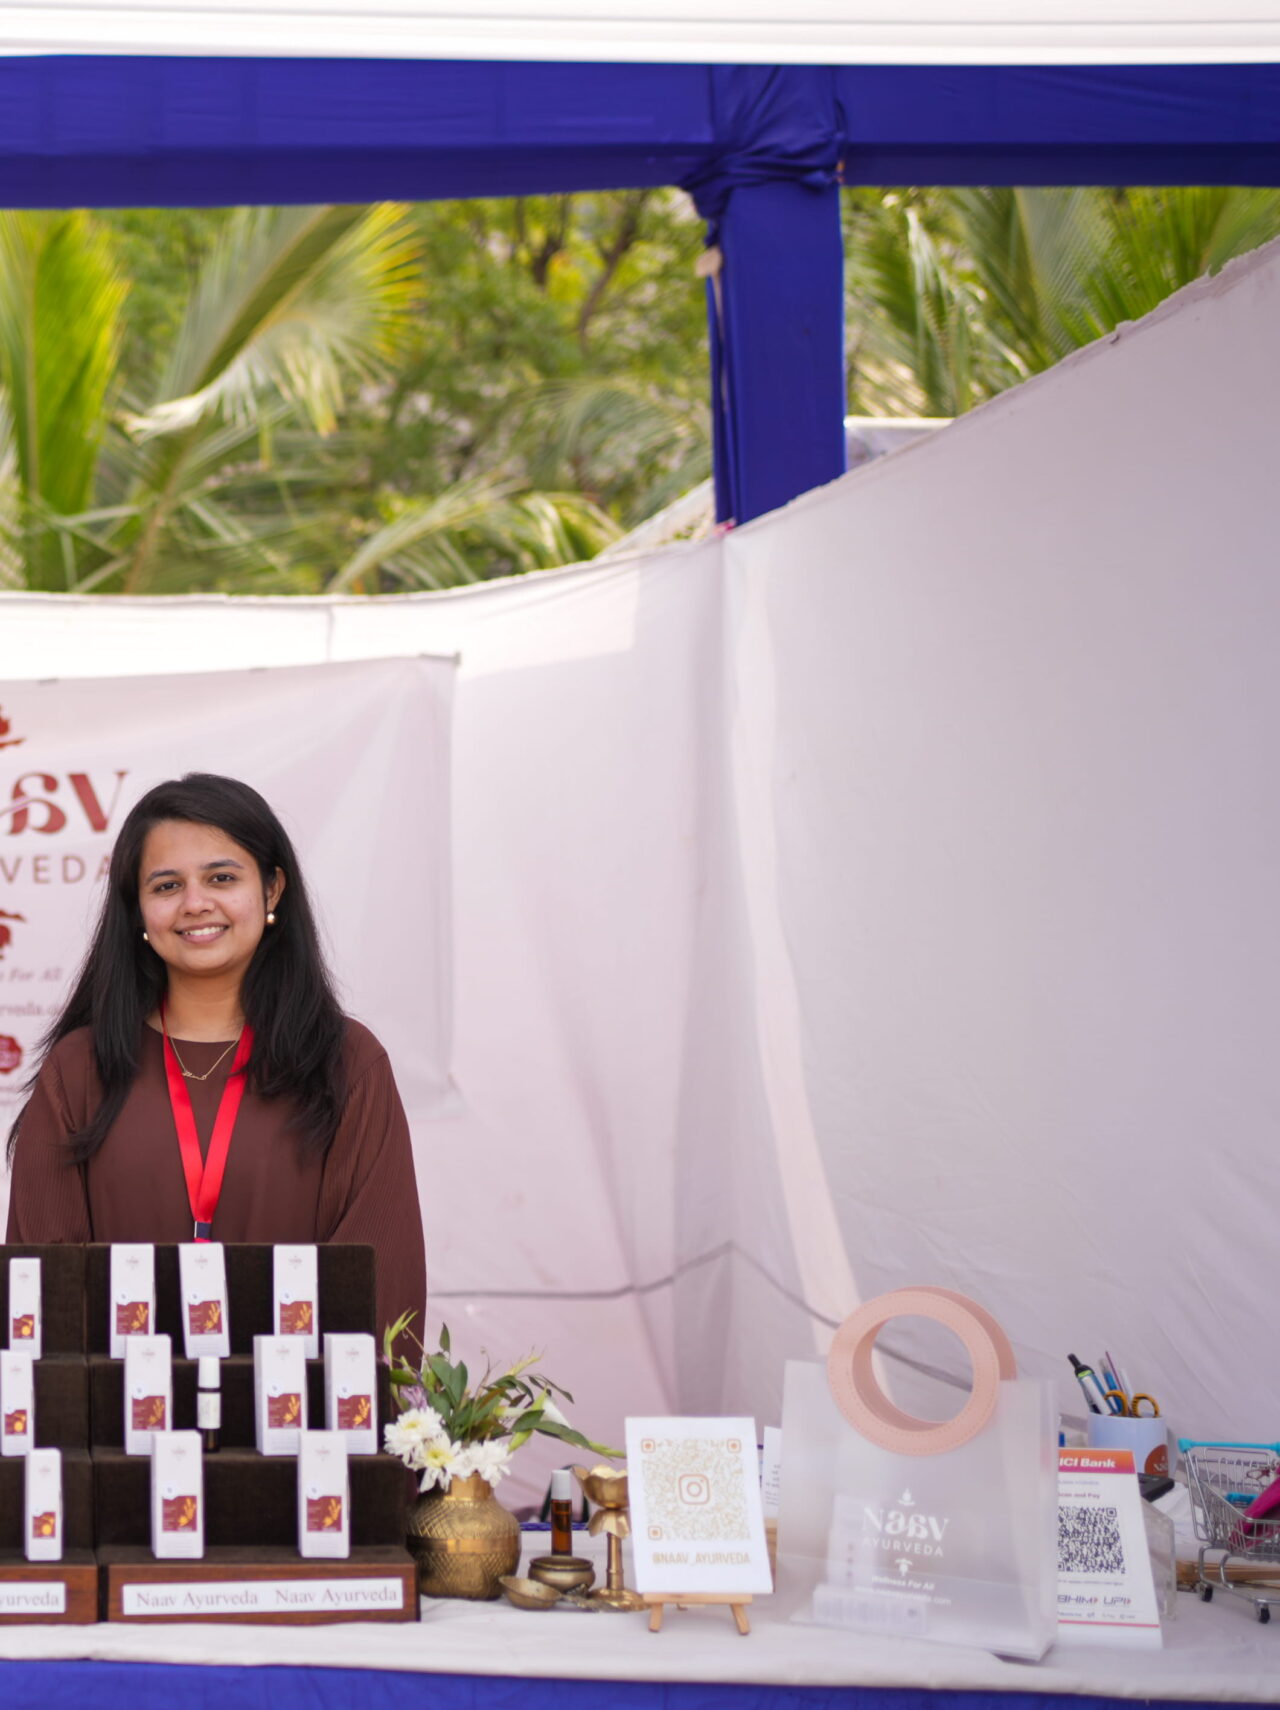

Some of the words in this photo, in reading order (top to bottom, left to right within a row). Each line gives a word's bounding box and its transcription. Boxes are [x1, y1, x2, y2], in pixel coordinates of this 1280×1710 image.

[1059, 1457, 1079, 1467] ICI
[1080, 1458, 1117, 1468] Bank
[864, 1537, 944, 1558] AYURVEDA
[136, 1591, 177, 1608] Naav
[183, 1591, 258, 1610] Ayurveda
[275, 1587, 317, 1605] Naav
[320, 1587, 398, 1607] Ayurveda
